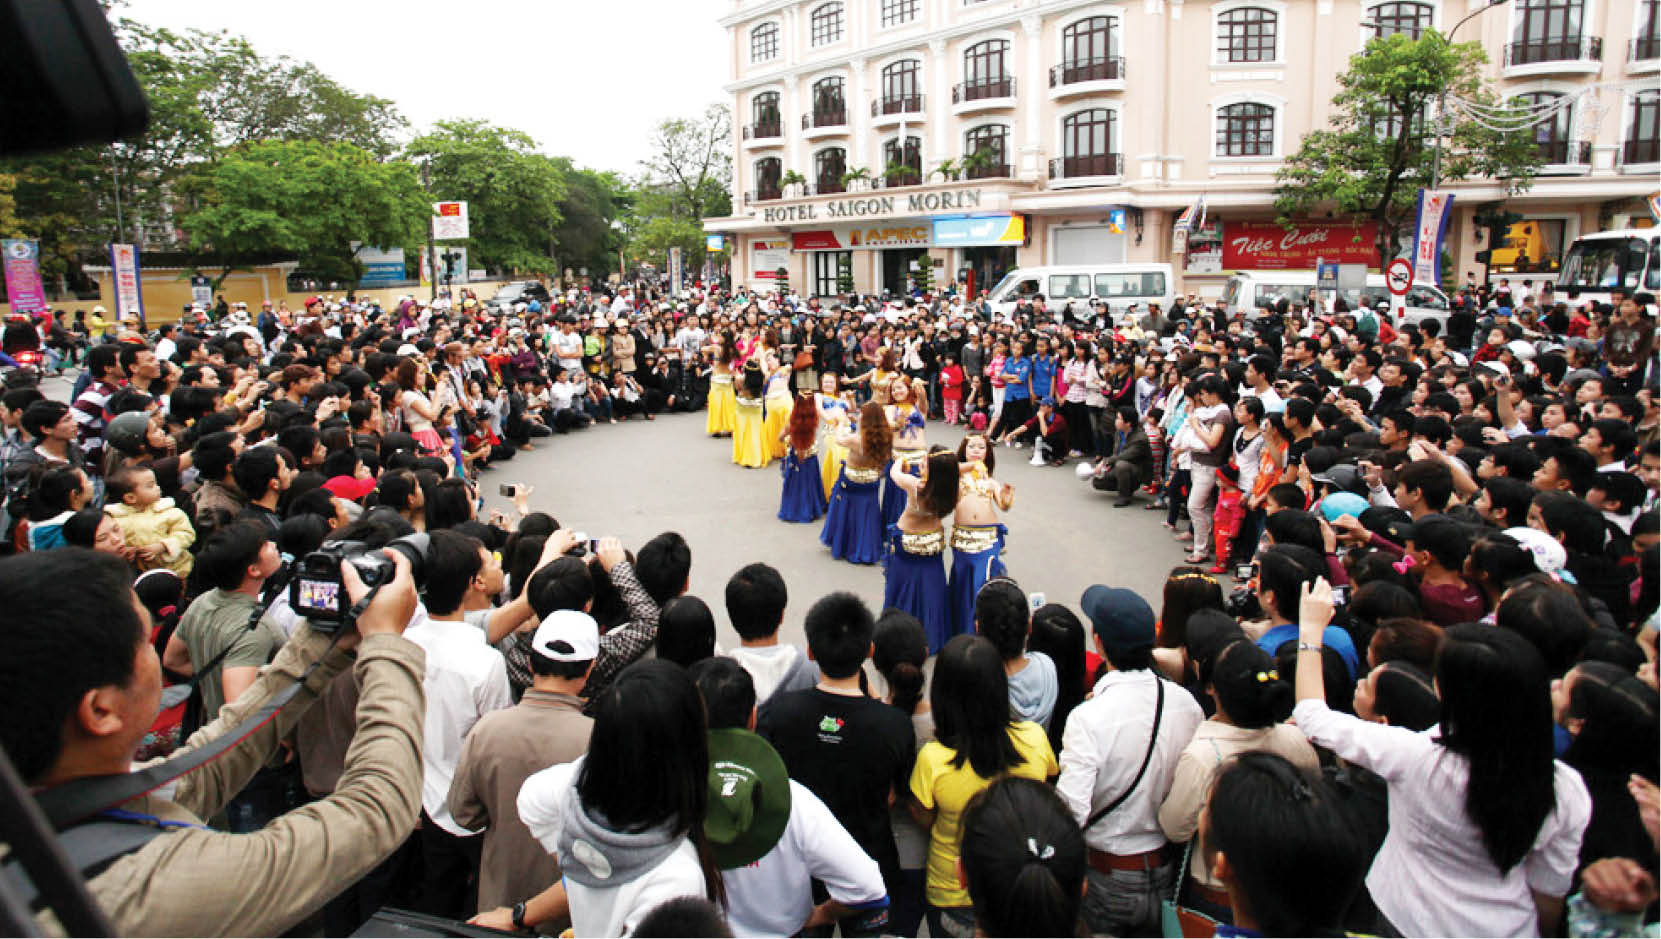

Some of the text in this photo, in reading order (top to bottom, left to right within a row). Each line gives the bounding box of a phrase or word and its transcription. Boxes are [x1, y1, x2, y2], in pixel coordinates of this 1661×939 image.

[764, 190, 981, 222] HOTEL SAIGON MORIN
[865, 226, 929, 241] APEC
